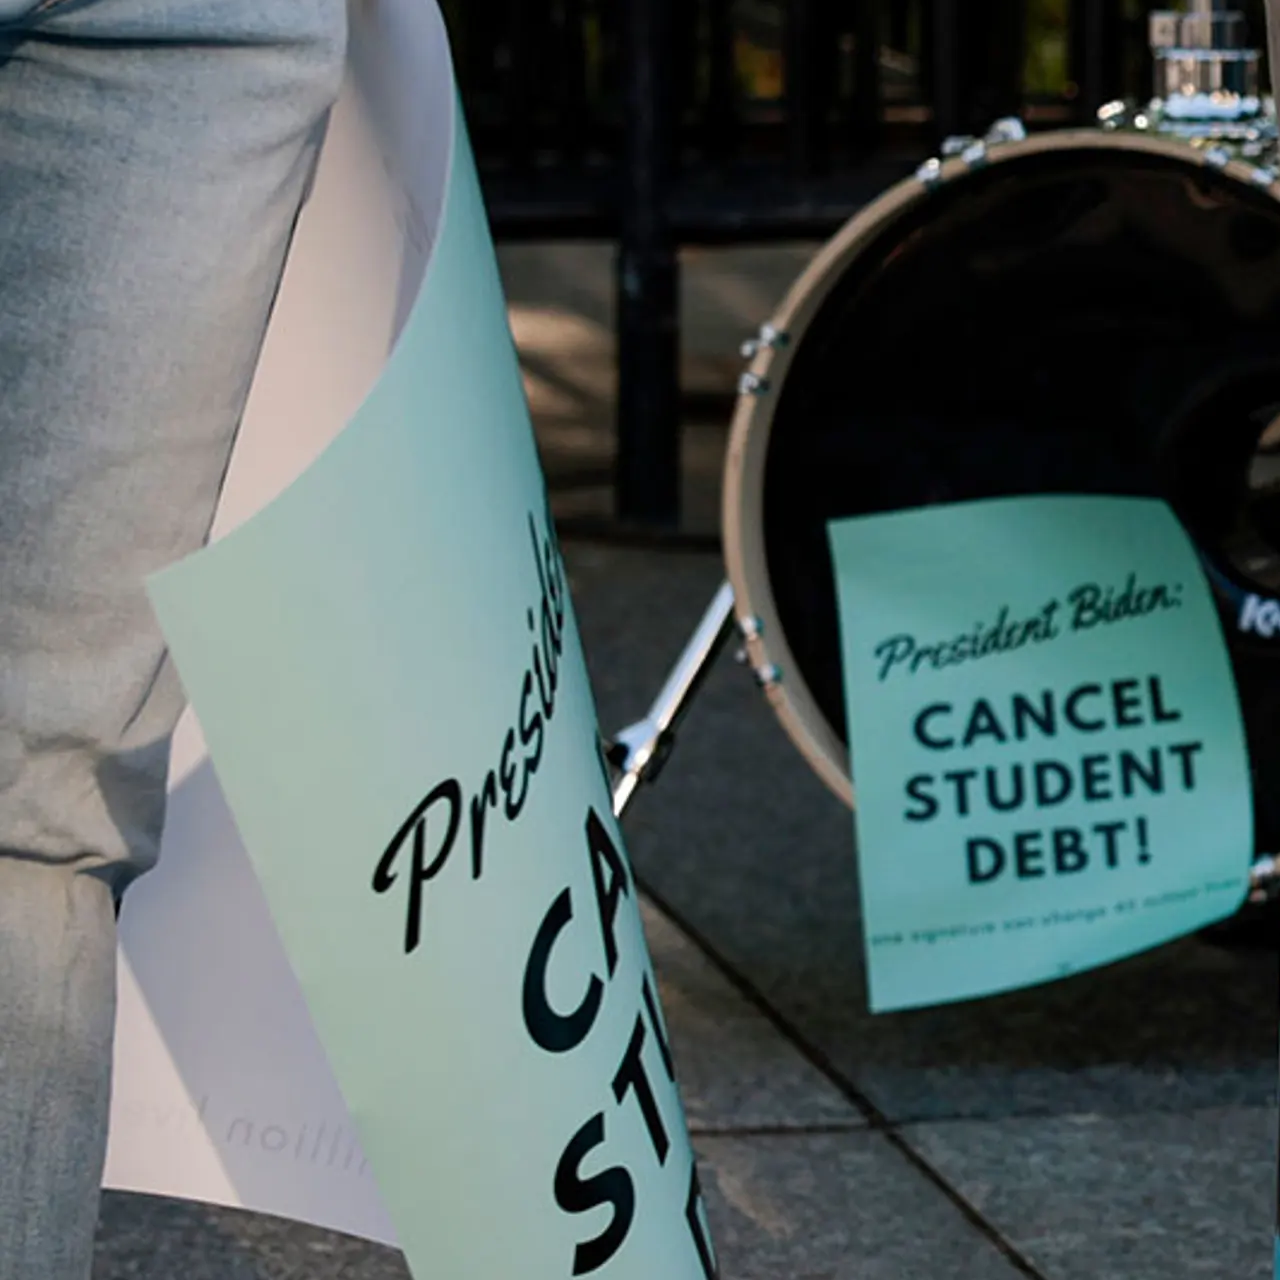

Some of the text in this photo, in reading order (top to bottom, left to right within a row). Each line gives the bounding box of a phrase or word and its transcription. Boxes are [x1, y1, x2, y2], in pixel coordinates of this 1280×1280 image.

[874, 599, 1060, 682] President
[1067, 573, 1183, 631] Biden:
[912, 675, 1182, 752] CANCEL
[903, 741, 1204, 822] STUDENT
[966, 817, 1153, 886] DEBT!
